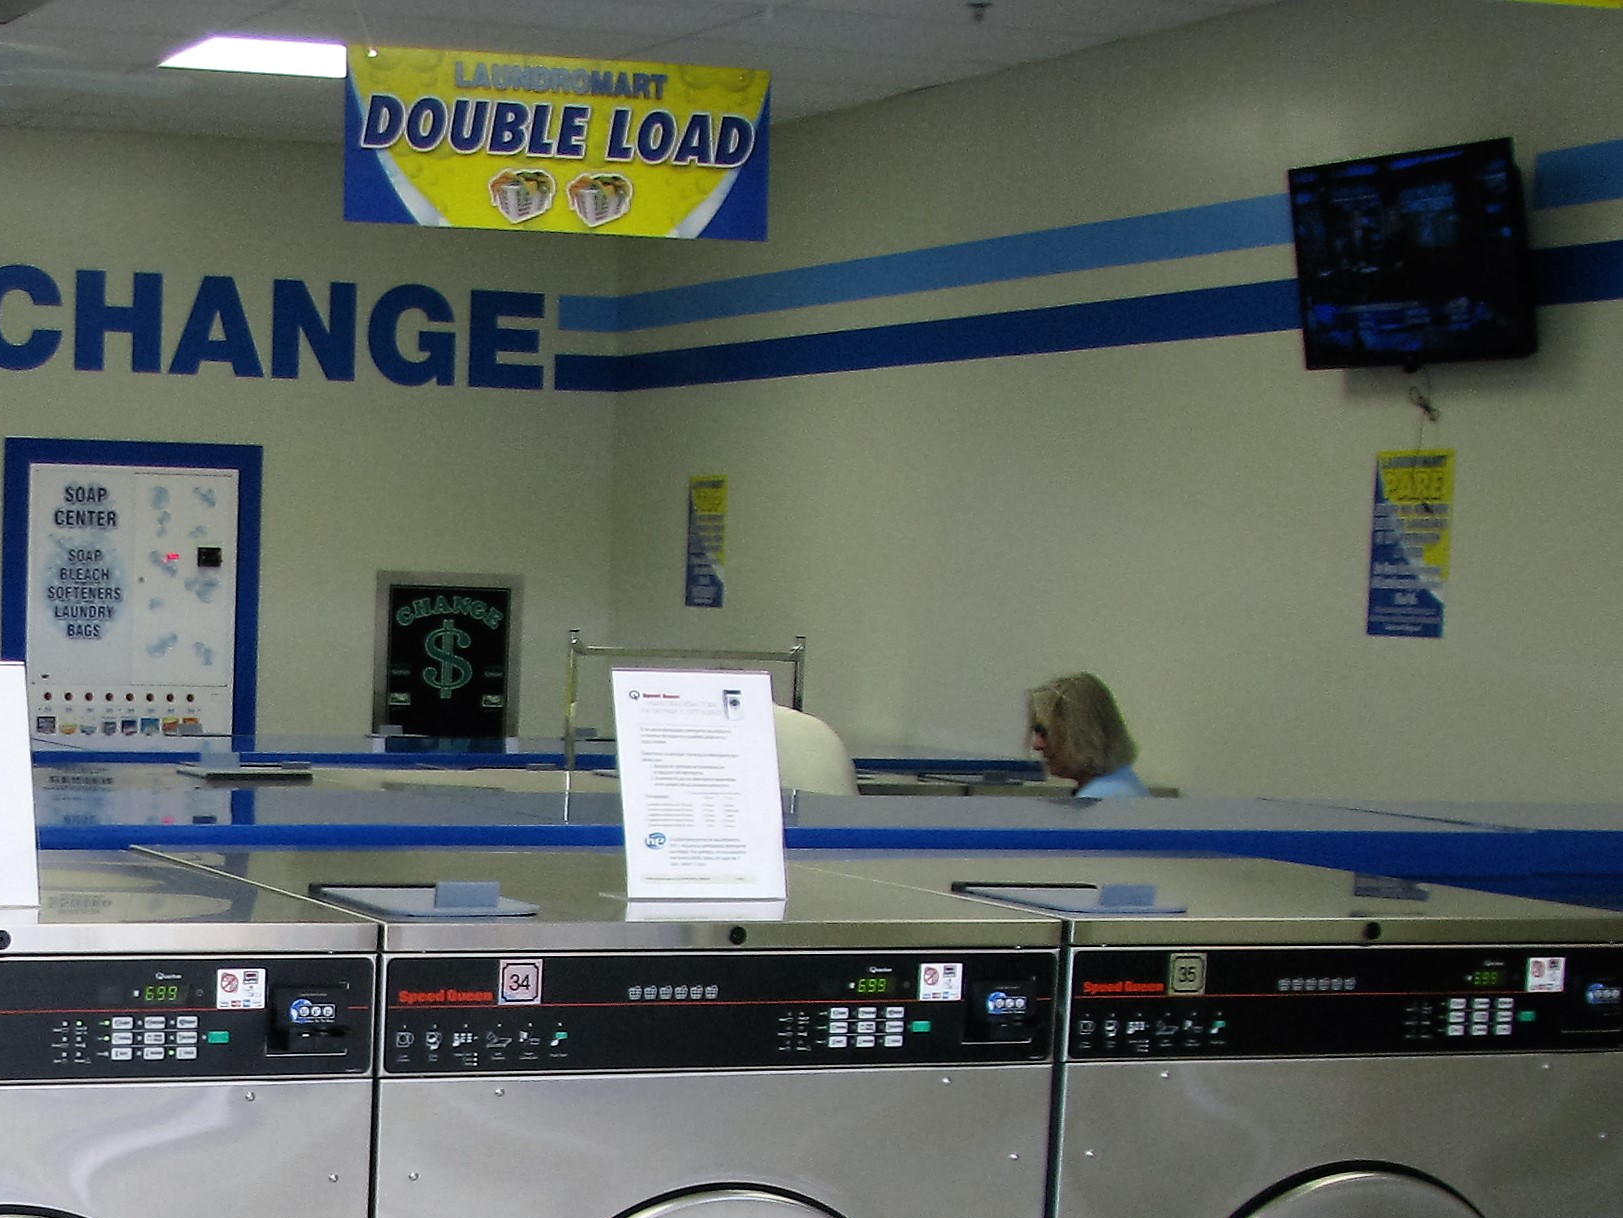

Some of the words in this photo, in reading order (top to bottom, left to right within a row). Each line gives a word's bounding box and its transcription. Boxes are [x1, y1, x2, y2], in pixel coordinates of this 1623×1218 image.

[455, 62, 668, 100] LAUNDROMART
[361, 94, 591, 160] DOUBLE
[605, 107, 755, 169] LOAD
[64, 486, 108, 503] SOAP
[54, 510, 117, 528] CENTER
[68, 549, 102, 562] SOAP
[60, 568, 109, 581] BLEACH
[48, 586, 121, 601] SOFTENERS
[54, 606, 115, 620] LAUNDRY
[396, 595, 504, 629] CHANGE
[67, 624, 101, 639] BAGS
[508, 973, 532, 991] 34
[1178, 966, 1197, 983] 35
